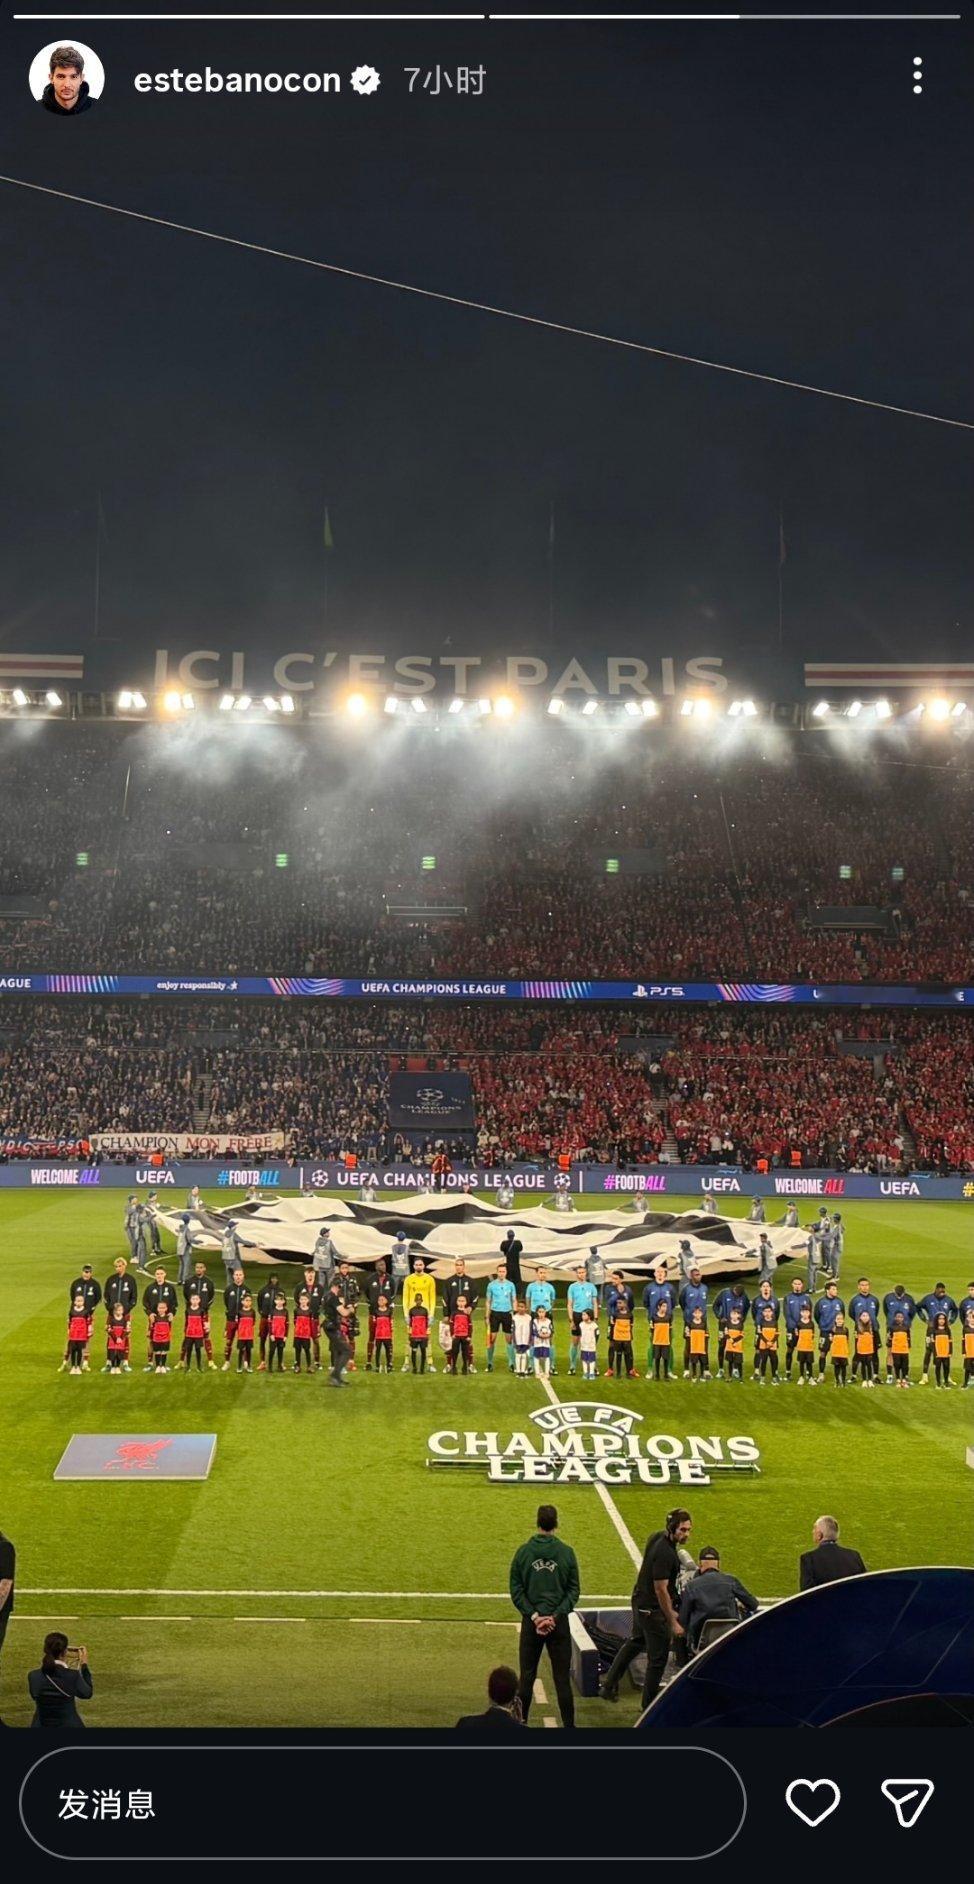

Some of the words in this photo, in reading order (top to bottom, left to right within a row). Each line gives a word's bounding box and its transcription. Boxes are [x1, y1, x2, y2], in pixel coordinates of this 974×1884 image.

[154, 649, 244, 690] ICI
[273, 652, 482, 695] C'EST
[506, 657, 728, 697] PARIS
[156, 981, 178, 991] enjoy
[179, 981, 226, 991] responsibly
[361, 983, 390, 993] UEFA
[392, 983, 460, 994] CHAMPIONS
[462, 984, 506, 995] LEAGUE
[650, 986, 685, 996] PS5
[101, 1137, 179, 1151] CHAMPION
[186, 1137, 219, 1149] MON
[31, 1169, 78, 1184] WELCOME
[79, 1170, 100, 1184] ALL
[136, 1170, 175, 1184] UEFA
[217, 1170, 279, 1186] #FOOTBALL
[337, 1173, 378, 1186] UEFA
[485, 1173, 545, 1188] LEAGUE
[603, 1175, 666, 1190] #FOOTBALL
[701, 1177, 740, 1191] UEFA
[775, 1178, 823, 1194] WELCOME
[823, 1179, 845, 1194] ALL
[880, 1181, 920, 1195] UEFA
[534, 1406, 634, 1434] UEFA
[428, 1430, 760, 1462] CHAMPIONS
[487, 1455, 711, 1485] LEAGUE
